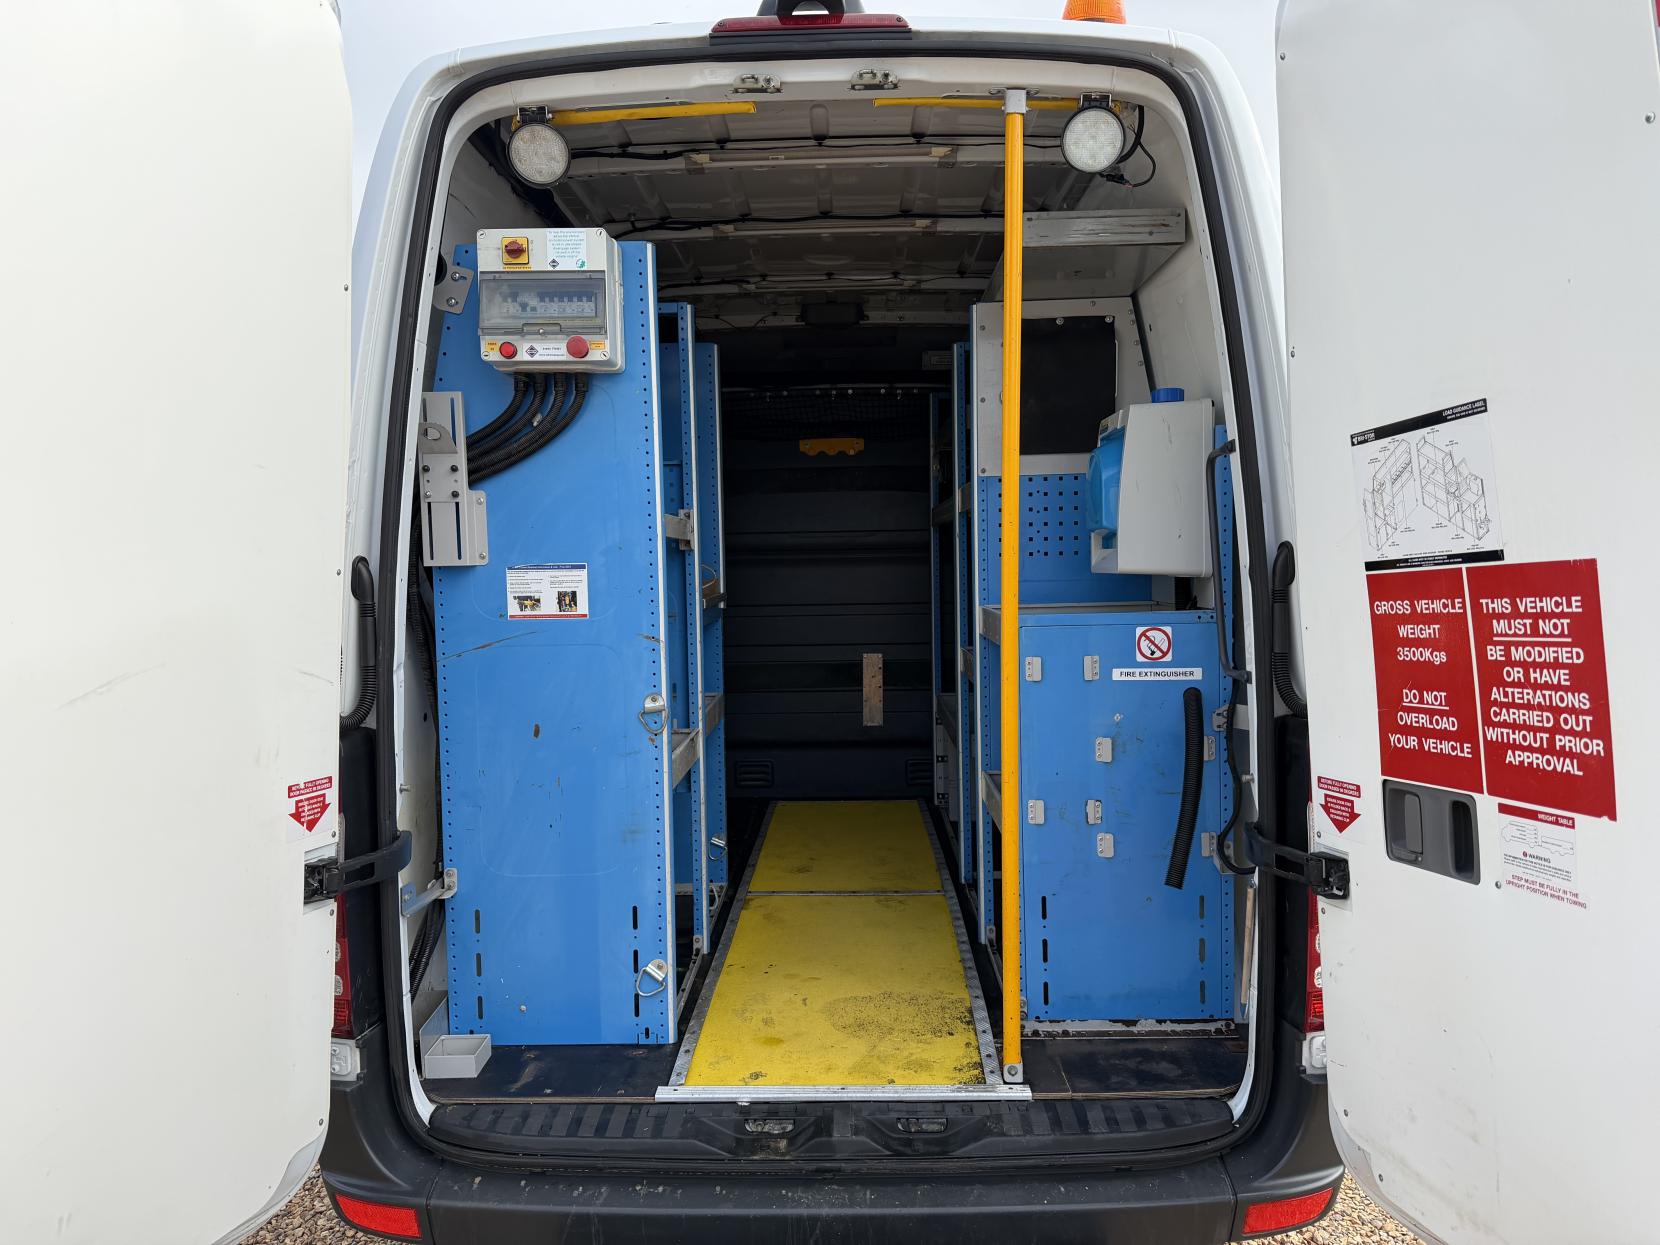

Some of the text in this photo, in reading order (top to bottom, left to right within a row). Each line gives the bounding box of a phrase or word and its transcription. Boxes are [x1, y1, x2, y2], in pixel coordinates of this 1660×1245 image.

[1453, 404, 1472, 413] GUIDANCE
[1472, 400, 1485, 408] LABEL
[1374, 599, 1463, 614] GROSS VEHICLE
[1480, 596, 1582, 614] THIS VEHICLE
[1397, 625, 1440, 638] WEIGHT
[1492, 618, 1570, 635] MUST NOT
[1397, 647, 1446, 664] 3500Kgs
[1487, 646, 1584, 663] BE MODIFIED
[1139, 670, 1194, 678] EXTINGUISHER
[1503, 667, 1570, 685] OR HAVE
[1403, 689, 1446, 705] DO NOT
[1491, 687, 1590, 710] ALTERATIONS
[1398, 712, 1458, 730] OVERLOAD
[1490, 707, 1593, 732] CARRIED OUT
[1388, 733, 1472, 758] YOUR VEHICLE
[1485, 726, 1604, 756] WITHOUT PRIOR
[1505, 750, 1583, 776] APPROVAL
[1538, 813, 1573, 826] WEIGHT TABLE
[1528, 853, 1551, 863] WARNING
[1506, 880, 1587, 909] UPRIGHT POSITION WHEN TOWING
[1512, 874, 1523, 882] STEP
[1524, 878, 1538, 886] MUST
[1546, 884, 1561, 893] FULLY
[1569, 890, 1579, 899] THE
